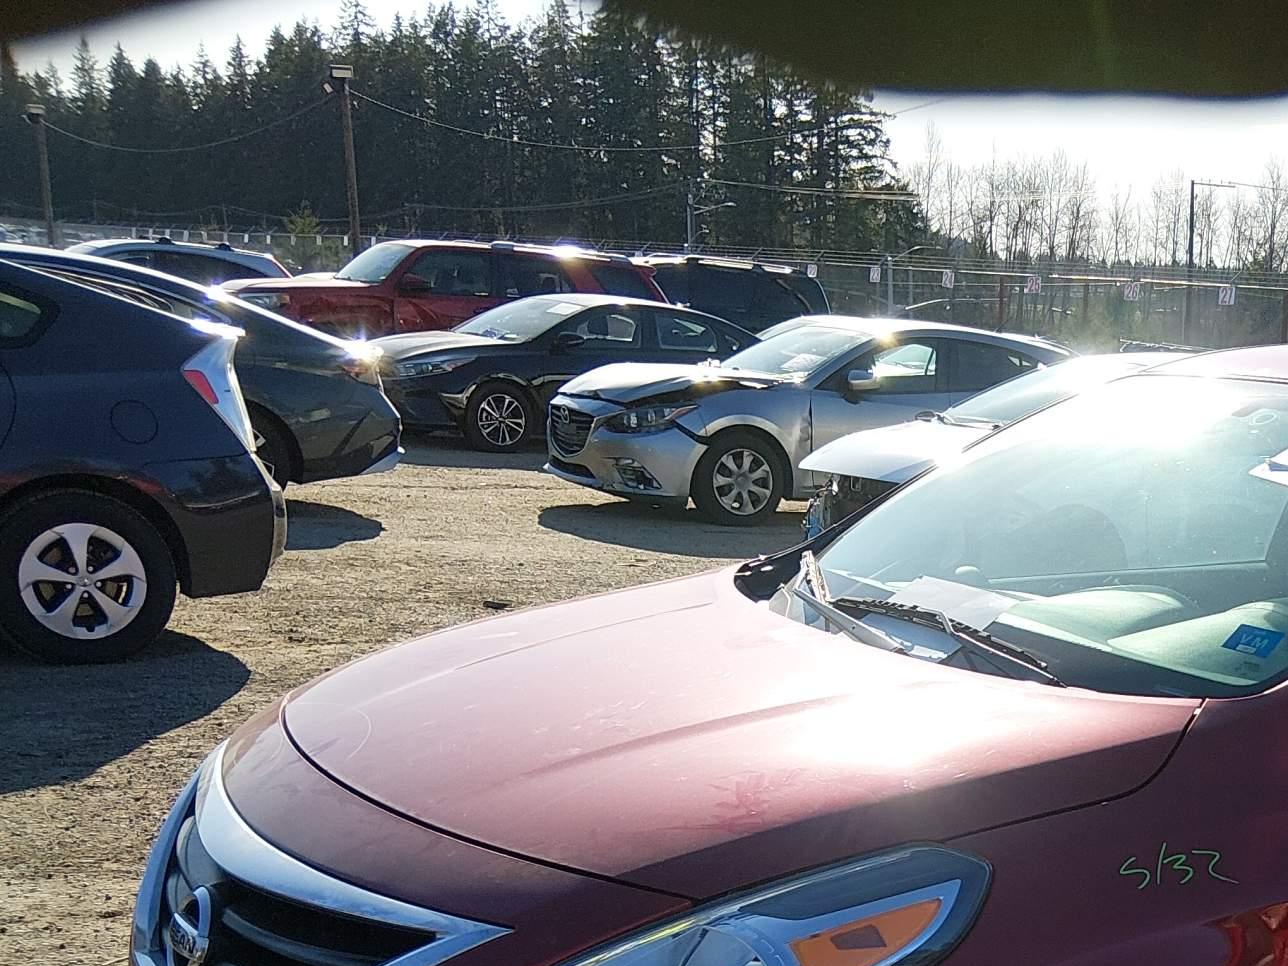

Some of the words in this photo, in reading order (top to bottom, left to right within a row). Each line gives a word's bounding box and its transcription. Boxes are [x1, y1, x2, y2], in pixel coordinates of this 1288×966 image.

[1028, 278, 1041, 292] 25
[1126, 284, 1139, 299] 26
[1221, 288, 1234, 305] 27
